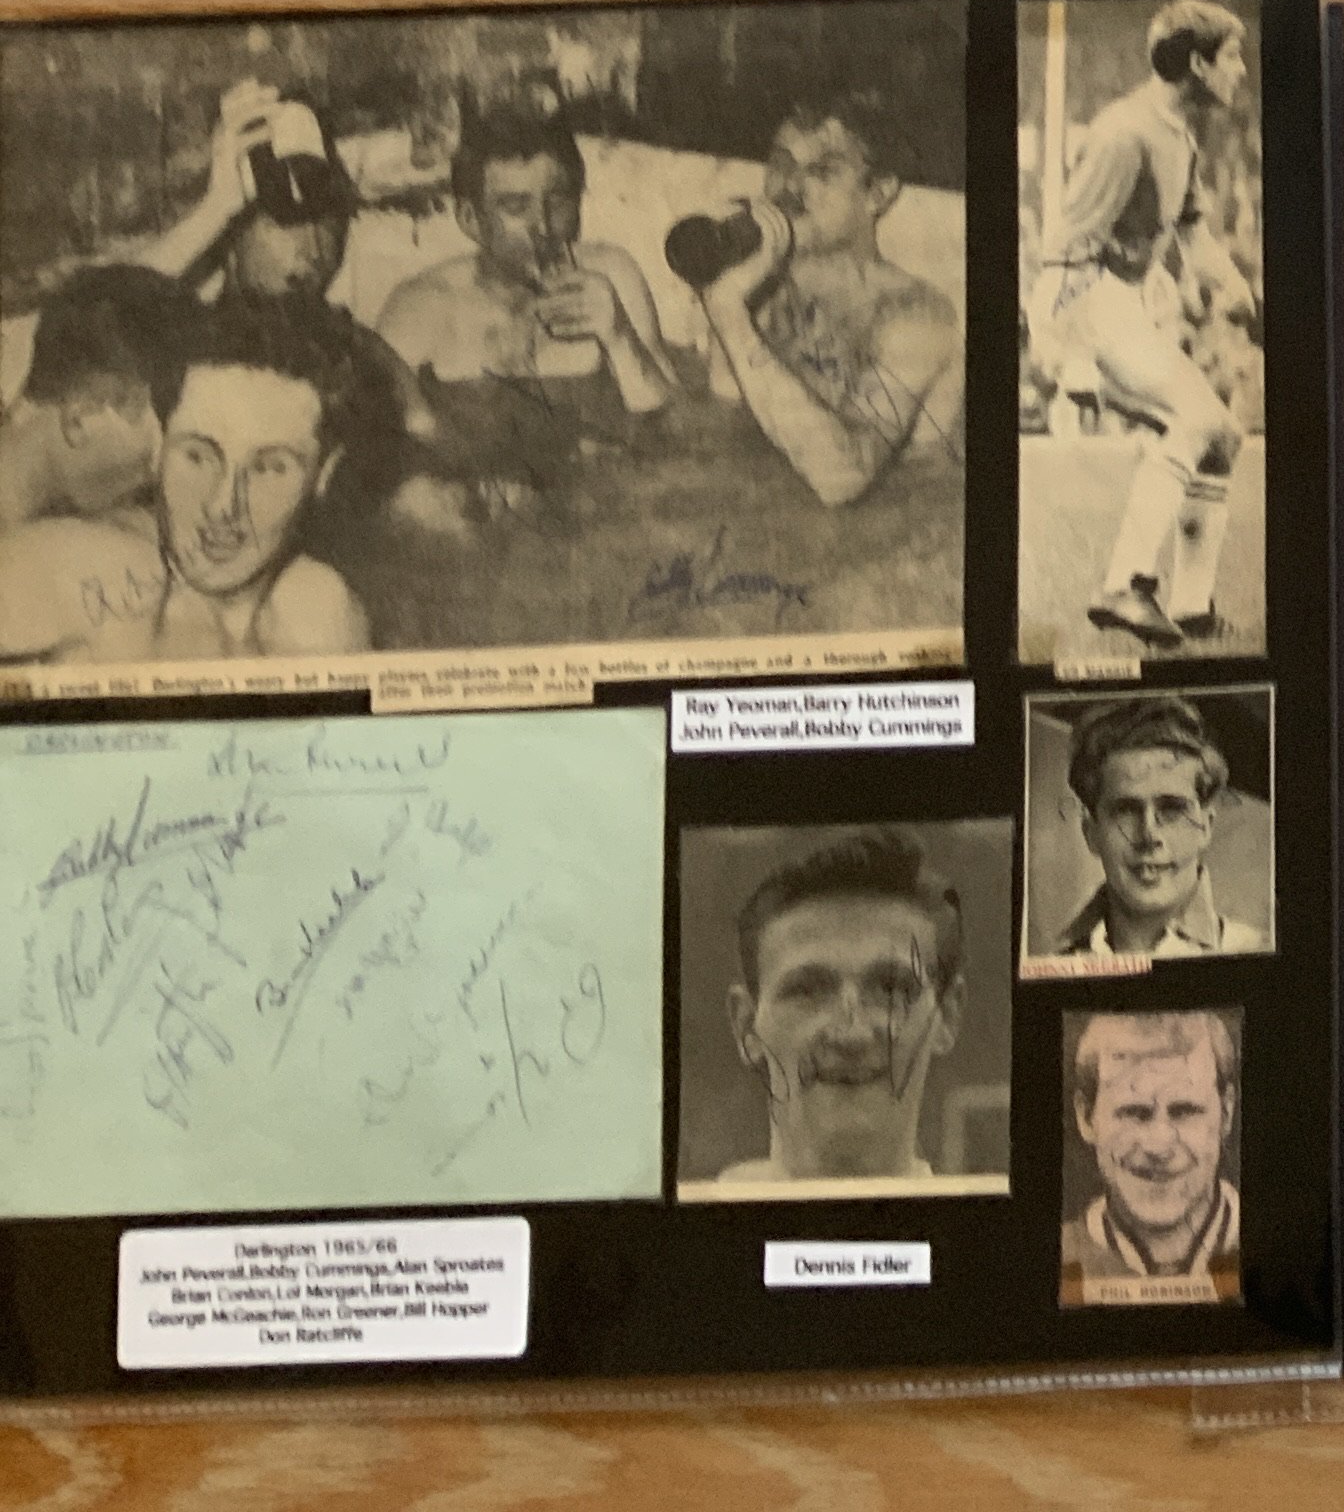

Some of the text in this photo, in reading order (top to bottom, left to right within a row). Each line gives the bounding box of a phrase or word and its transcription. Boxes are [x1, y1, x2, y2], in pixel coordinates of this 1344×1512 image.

[767, 653, 792, 667] and
[686, 696, 719, 716] Ray
[857, 691, 960, 712] Hutchinson
[680, 723, 723, 741] John
[868, 718, 962, 739] Cummings
[235, 1241, 316, 1262] Darlington
[795, 1255, 912, 1275] Dennis Fidler
[140, 1266, 177, 1284] John
[172, 1287, 212, 1304] Brian
[149, 1309, 206, 1328] George
[259, 1326, 364, 1345] Don Ratcliffe
